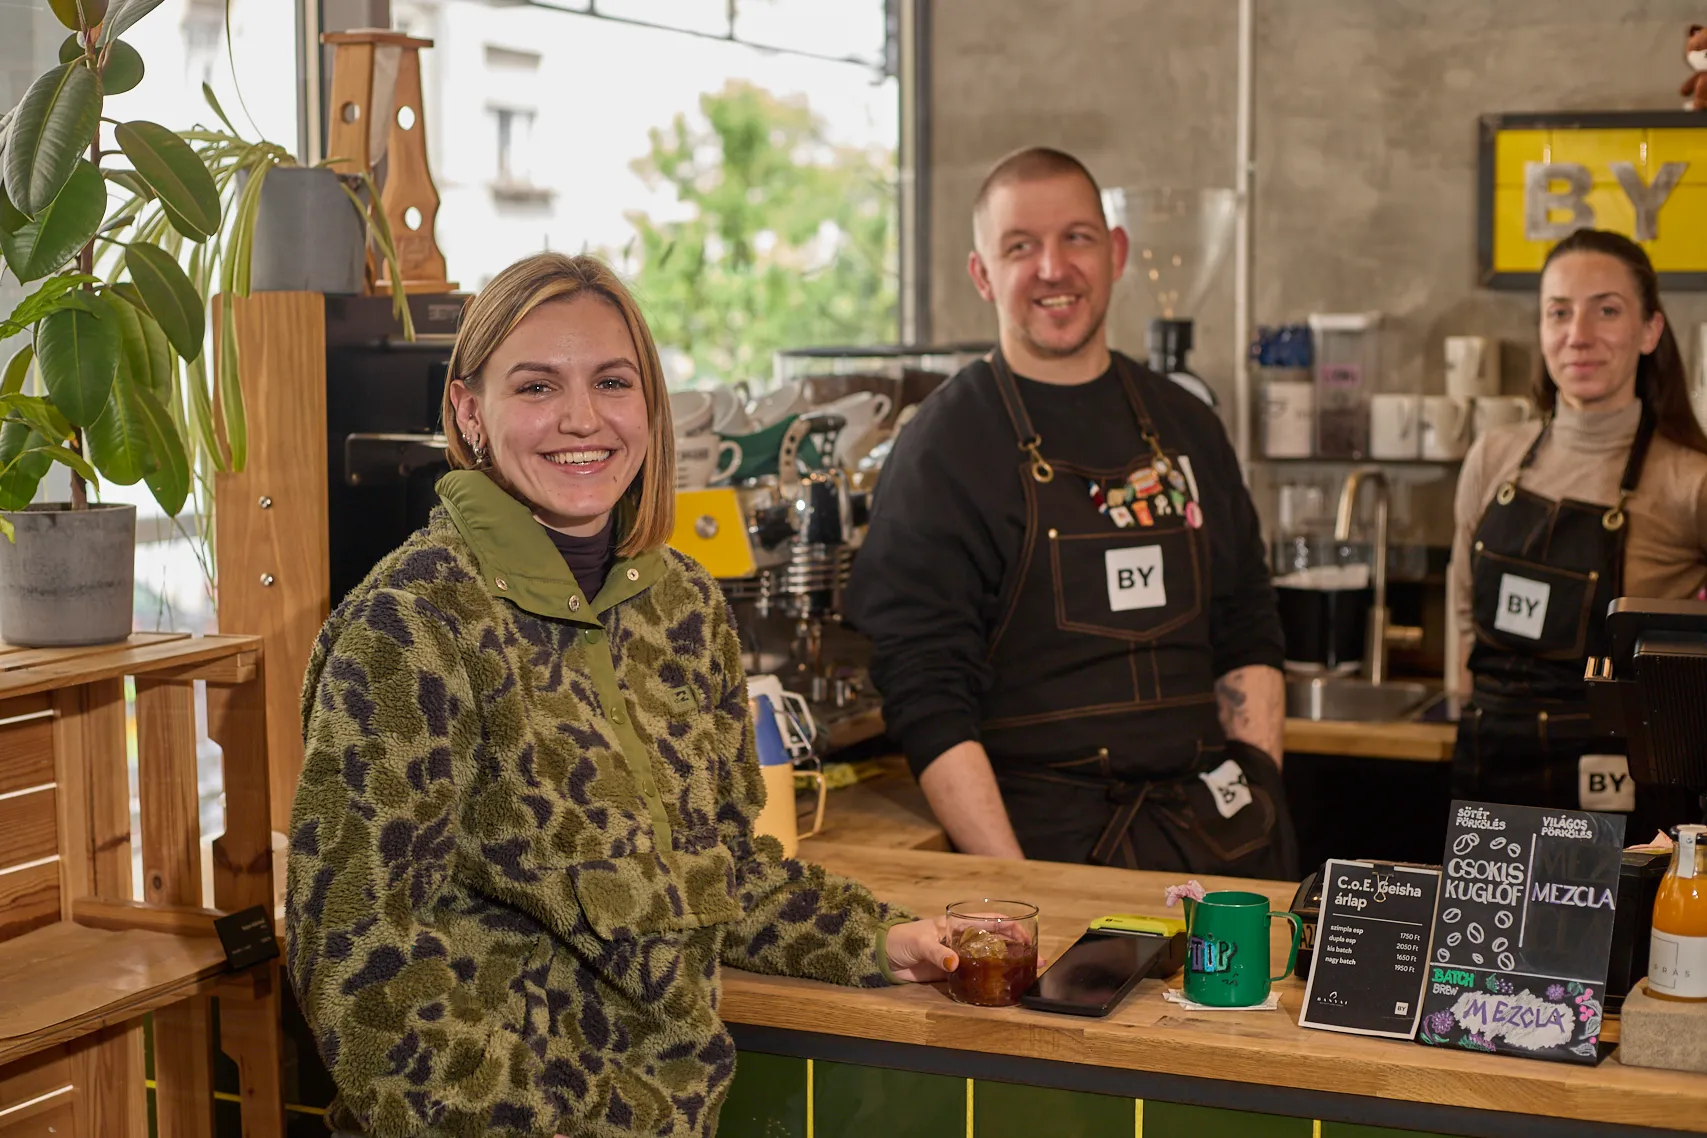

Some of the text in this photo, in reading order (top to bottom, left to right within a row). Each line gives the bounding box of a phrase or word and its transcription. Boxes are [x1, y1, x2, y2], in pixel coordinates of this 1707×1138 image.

[1524, 162, 1690, 241] BY
[1118, 566, 1154, 590] BY
[1508, 593, 1540, 618] BY
[1589, 772, 1627, 793] BY
[1457, 806, 1490, 820] SÖTÉT
[1542, 814, 1588, 831] VILÁGOS
[1456, 816, 1506, 830] PÖRKÖLÉS
[1448, 858, 1524, 884] CSOKIS
[1337, 876, 1422, 897] C.o.E. Geisha
[1445, 879, 1524, 906] KUGLÓF
[1532, 882, 1616, 910] MEZCLA
[1334, 892, 1367, 911] árlap
[1330, 925, 1364, 935] szimpla esp
[1400, 932, 1414, 940] 1750
[1328, 935, 1356, 945] dupla esp
[1336, 946, 1352, 954] batch
[1325, 956, 1356, 965] nagy batch
[1394, 964, 1408, 972] 1950
[1431, 968, 1475, 988] BATCH
[1432, 983, 1458, 996] BREW
[1462, 998, 1565, 1034] MEZCLA
